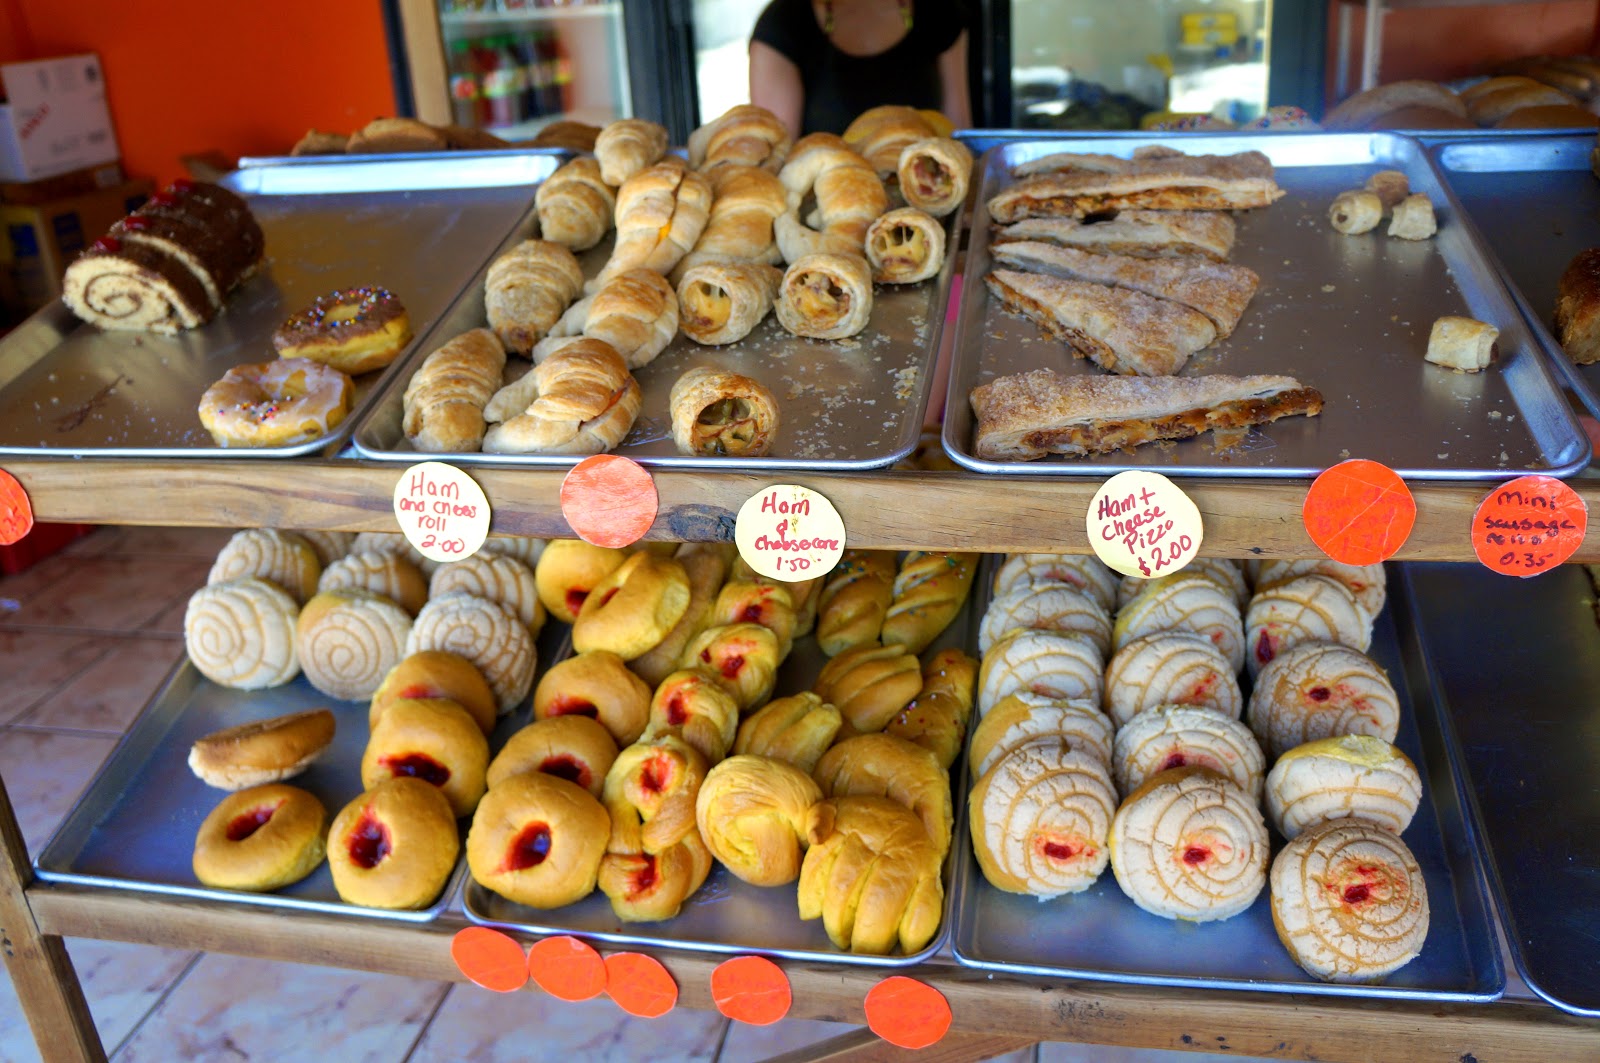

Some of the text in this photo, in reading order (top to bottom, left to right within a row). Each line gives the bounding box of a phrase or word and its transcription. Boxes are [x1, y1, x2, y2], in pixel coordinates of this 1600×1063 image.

[411, 471, 459, 500] Ham
[399, 497, 426, 513] and
[761, 491, 810, 516] Ham
[1097, 493, 1137, 521] Ham
[418, 514, 447, 532] roll
[421, 534, 465, 554] 2.00
[776, 556, 811, 572] 1.50
[1499, 552, 1554, 568] 0.35
